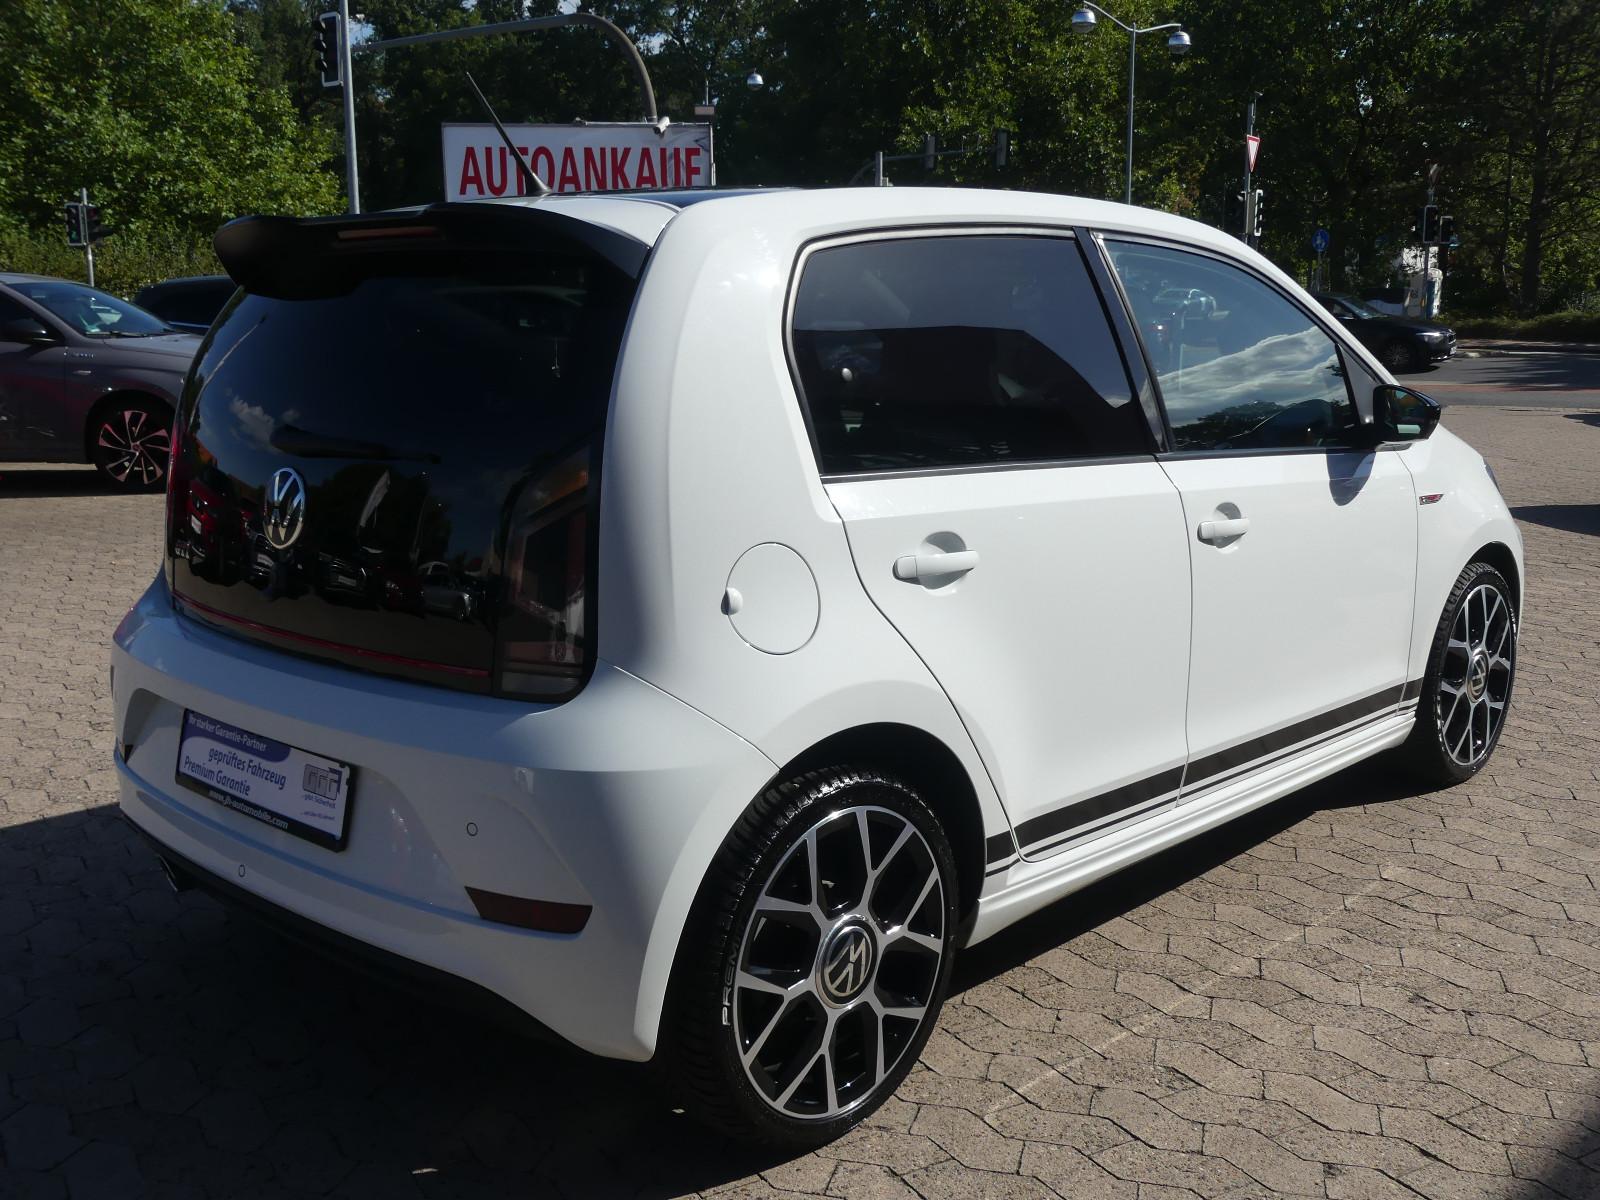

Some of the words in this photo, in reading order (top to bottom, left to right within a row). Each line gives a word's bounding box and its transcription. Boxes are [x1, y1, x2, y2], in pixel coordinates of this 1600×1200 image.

[460, 146, 701, 196] AUTOANKAUF
[215, 725, 267, 752] Garantie-Partner
[184, 756, 215, 781] Premium
[216, 771, 251, 796] Garantie
[208, 748, 245, 771] geprüftes
[246, 760, 287, 790] Fahrzeug
